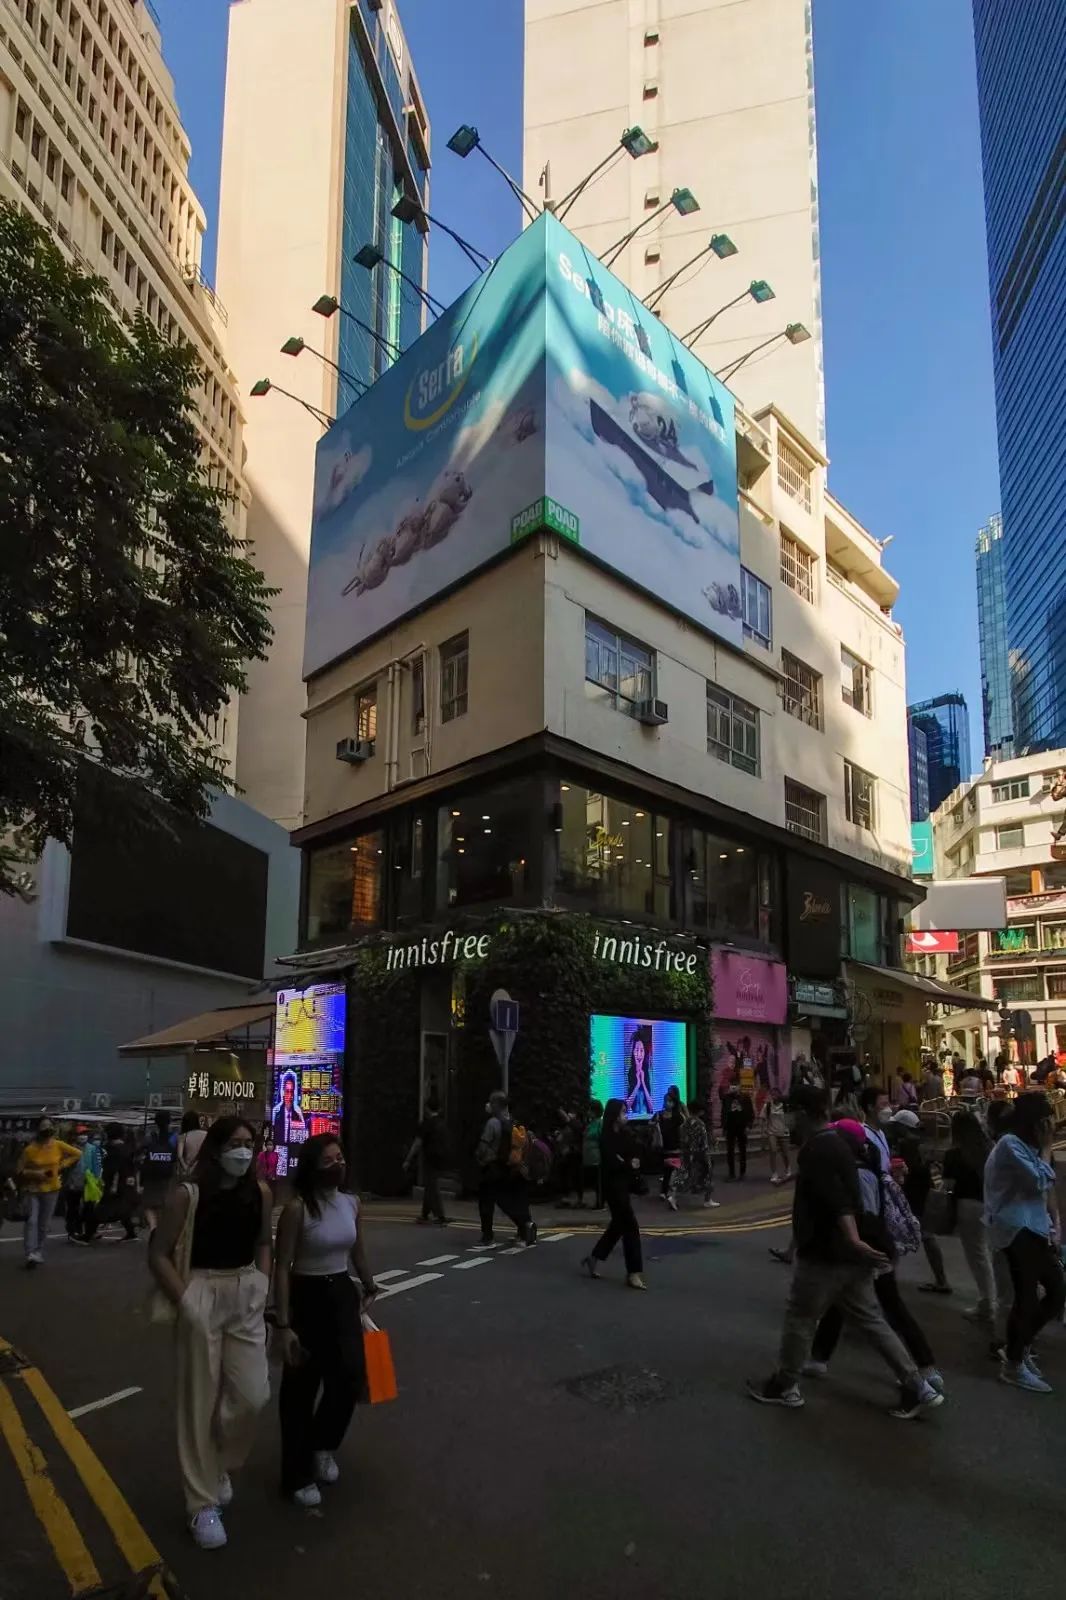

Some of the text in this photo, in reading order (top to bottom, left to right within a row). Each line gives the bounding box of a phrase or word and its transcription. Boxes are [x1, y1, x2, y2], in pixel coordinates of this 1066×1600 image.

[419, 345, 464, 410] Serta
[513, 500, 542, 533] POAD
[548, 499, 577, 531] POAD
[386, 931, 491, 970] innisfree
[593, 930, 698, 975] innisfree
[213, 1080, 255, 1100] BONJOUR
[150, 1151, 172, 1161] VANS
